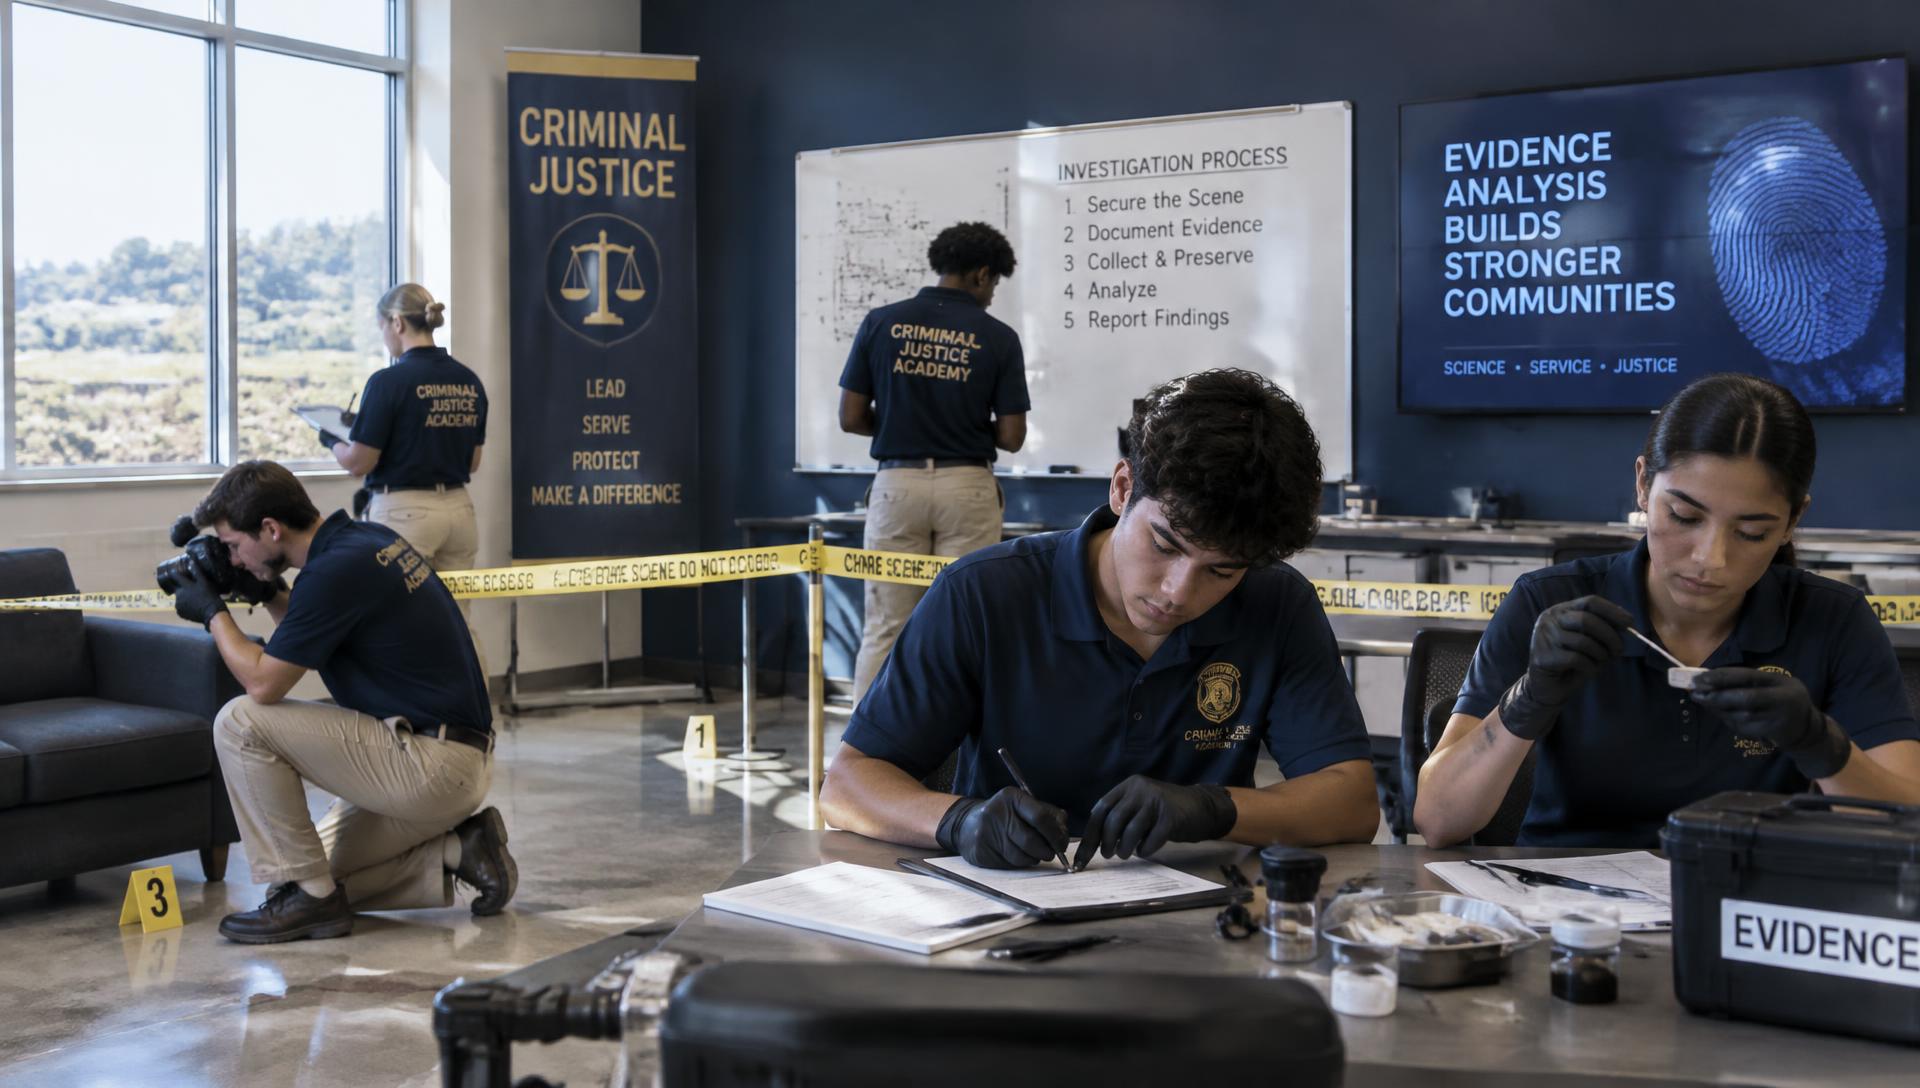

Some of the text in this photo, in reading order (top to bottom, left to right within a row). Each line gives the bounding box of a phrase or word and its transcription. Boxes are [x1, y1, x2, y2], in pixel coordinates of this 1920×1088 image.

[519, 106, 686, 151] CRIMINAL
[1058, 146, 1288, 181] INVESTIGATION PROCESS
[1444, 131, 1612, 172] EVIDENCE
[529, 156, 676, 198] JUSTICE
[1444, 170, 1607, 208] ANALYSIS
[1087, 195, 1147, 214] Secure
[1153, 190, 1182, 209] the
[1188, 188, 1244, 207] Scene
[1063, 216, 1263, 244] 2 Document Evidence
[1445, 210, 1562, 244] BUILDS
[1064, 248, 1254, 272] 3 Collect & Preserve
[1444, 245, 1622, 281] STRONGER
[1063, 280, 1157, 303] 4 Analyze
[1444, 281, 1676, 318] COMMUNITIES
[1064, 307, 1230, 332] 5 Report Findings
[899, 341, 970, 364] JUSTICE
[892, 358, 972, 382] ACADEMY
[1443, 357, 1678, 376] SCIENCE SERVICE JUSTICE
[416, 383, 478, 399] CRIMINAL
[586, 378, 626, 398] LEAD
[430, 398, 477, 413] JUSTICE
[425, 413, 479, 428] ACADEMY
[582, 414, 631, 435] SERVE
[572, 450, 641, 471] PROTECT
[532, 483, 681, 506] MAKE A DIFFERENCE
[695, 723, 705, 749] 1
[146, 877, 169, 918] 3
[1735, 914, 1920, 972] EVIDENCE
